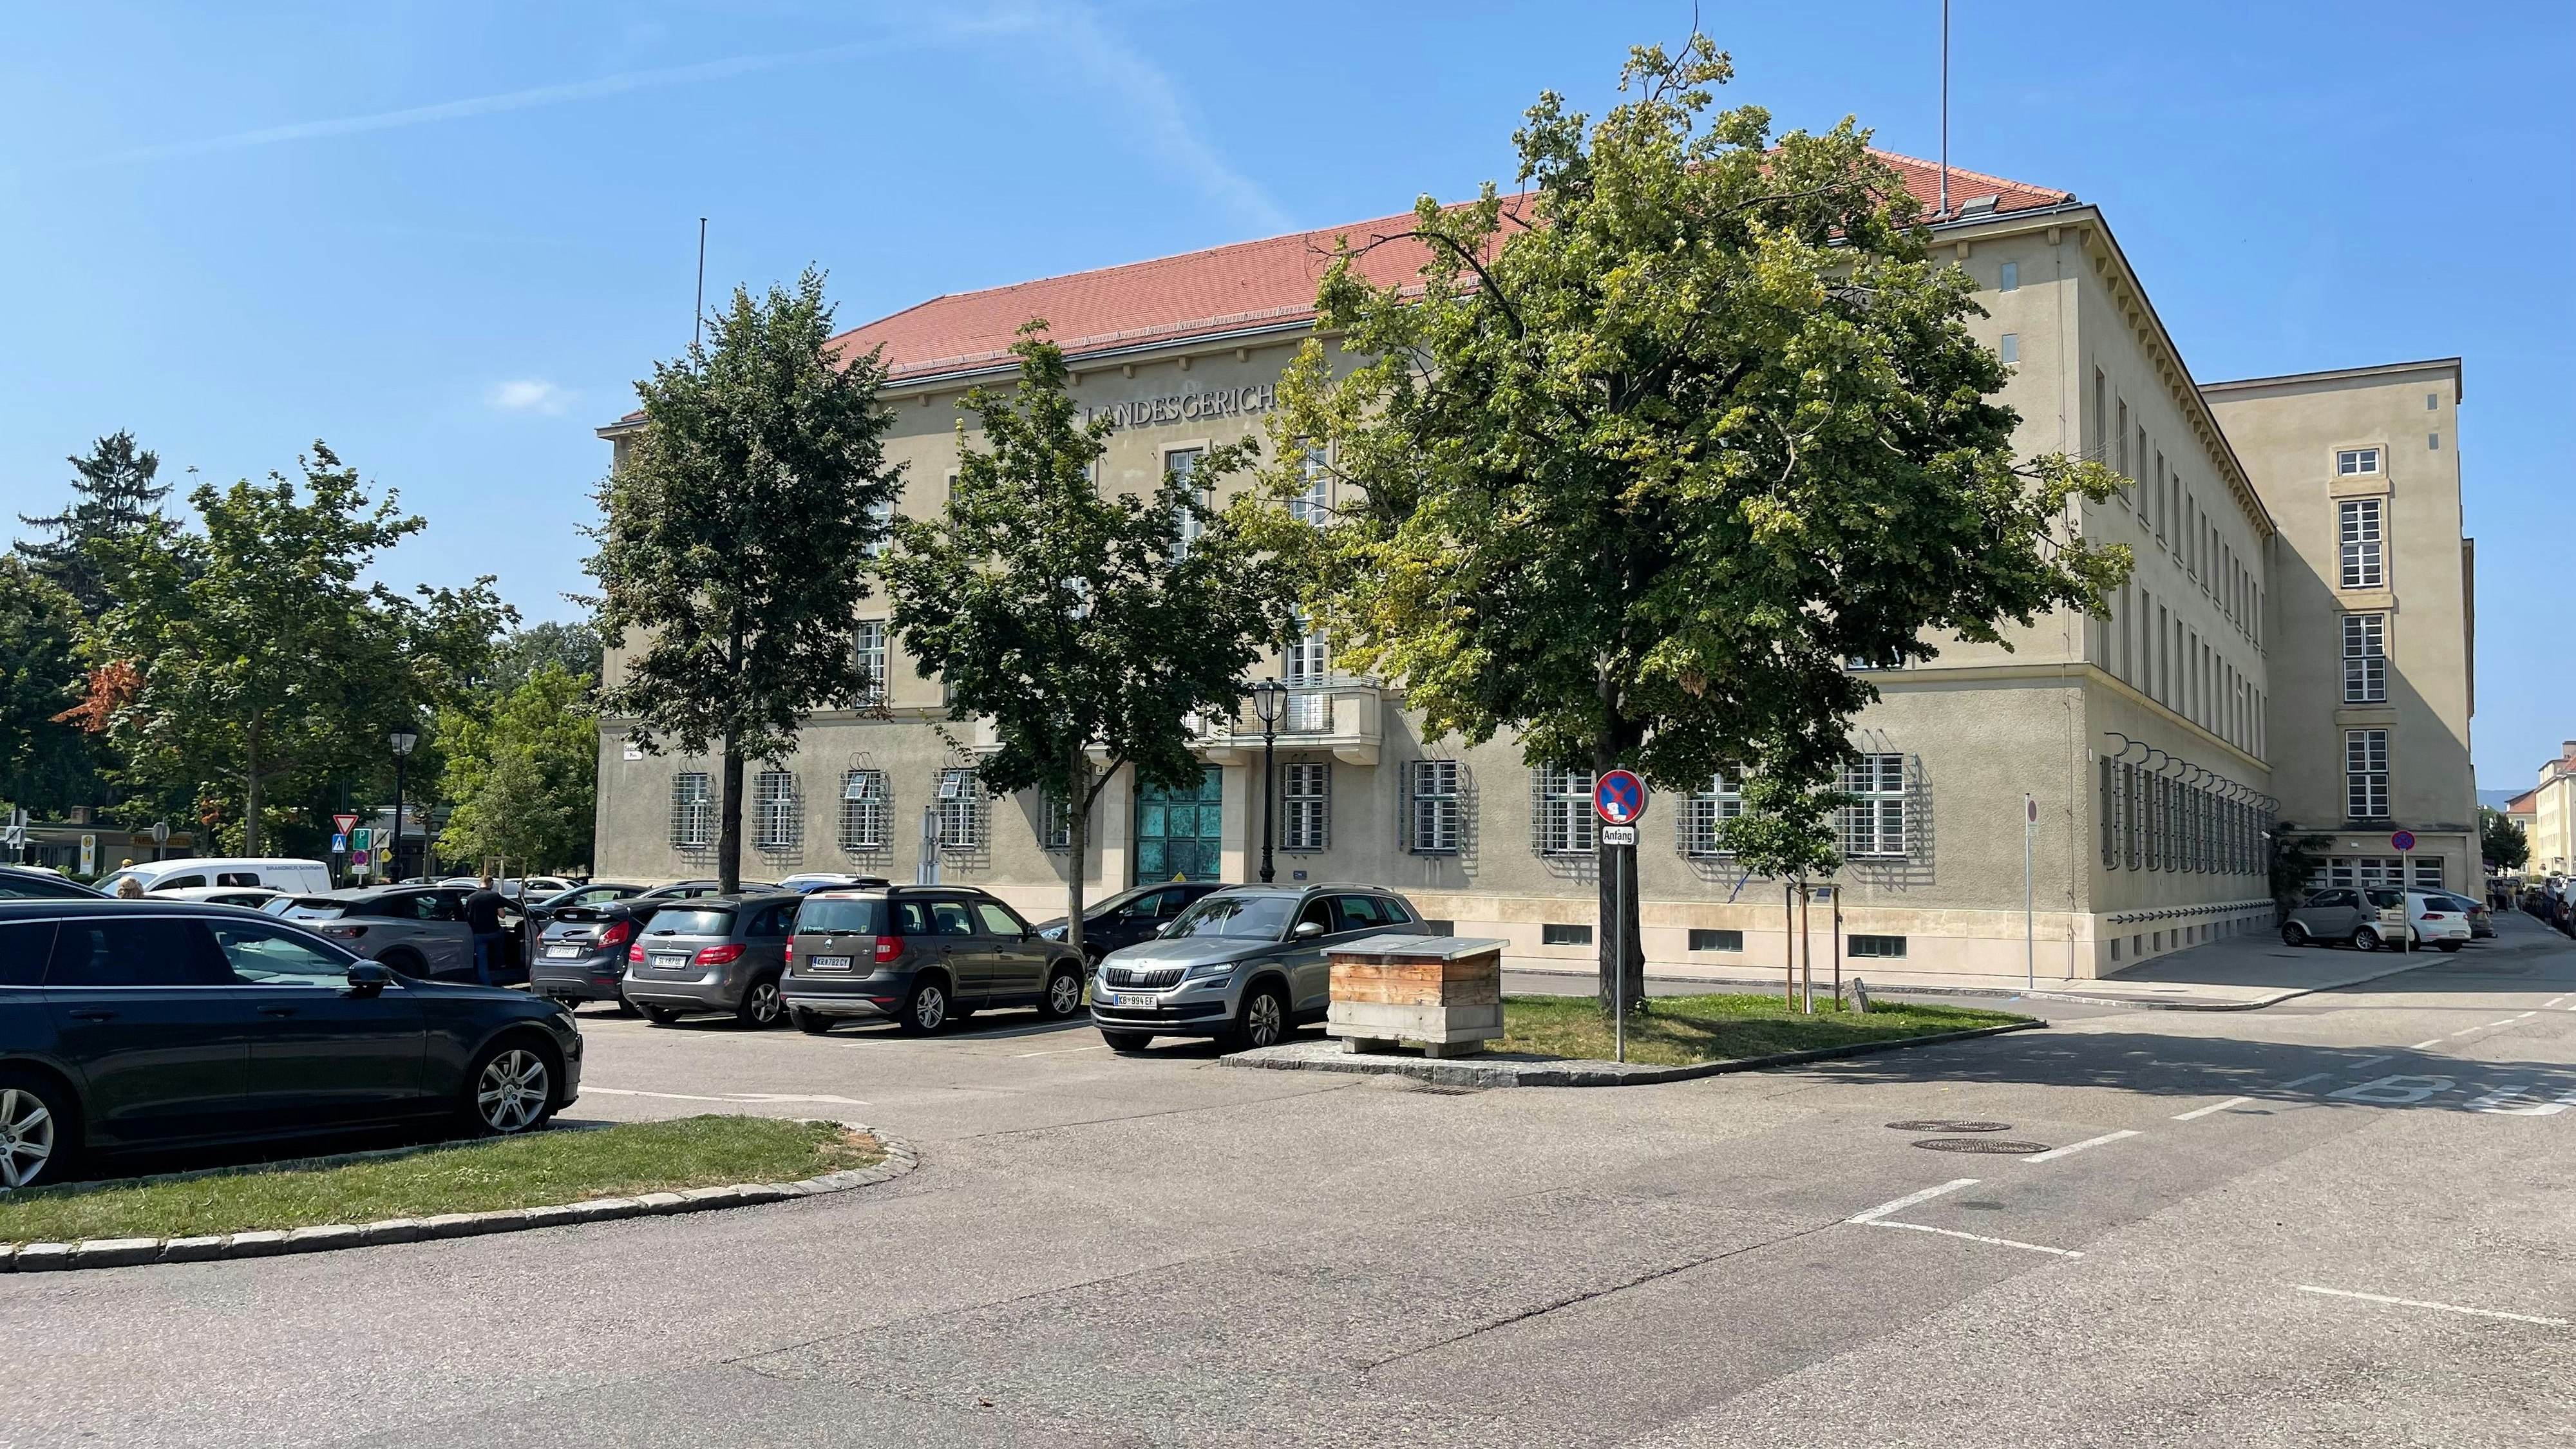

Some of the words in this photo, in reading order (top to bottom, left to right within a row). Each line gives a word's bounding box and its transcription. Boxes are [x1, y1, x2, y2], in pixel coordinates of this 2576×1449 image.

[1085, 383, 1278, 427] LANDESGERICH
[359, 831, 365, 839] P
[1604, 830, 1632, 843] Anfang
[817, 958, 825, 966] KR
[1119, 996, 1127, 1005] KB
[1132, 996, 1144, 1005] 994
[1145, 997, 1153, 1005] EF
